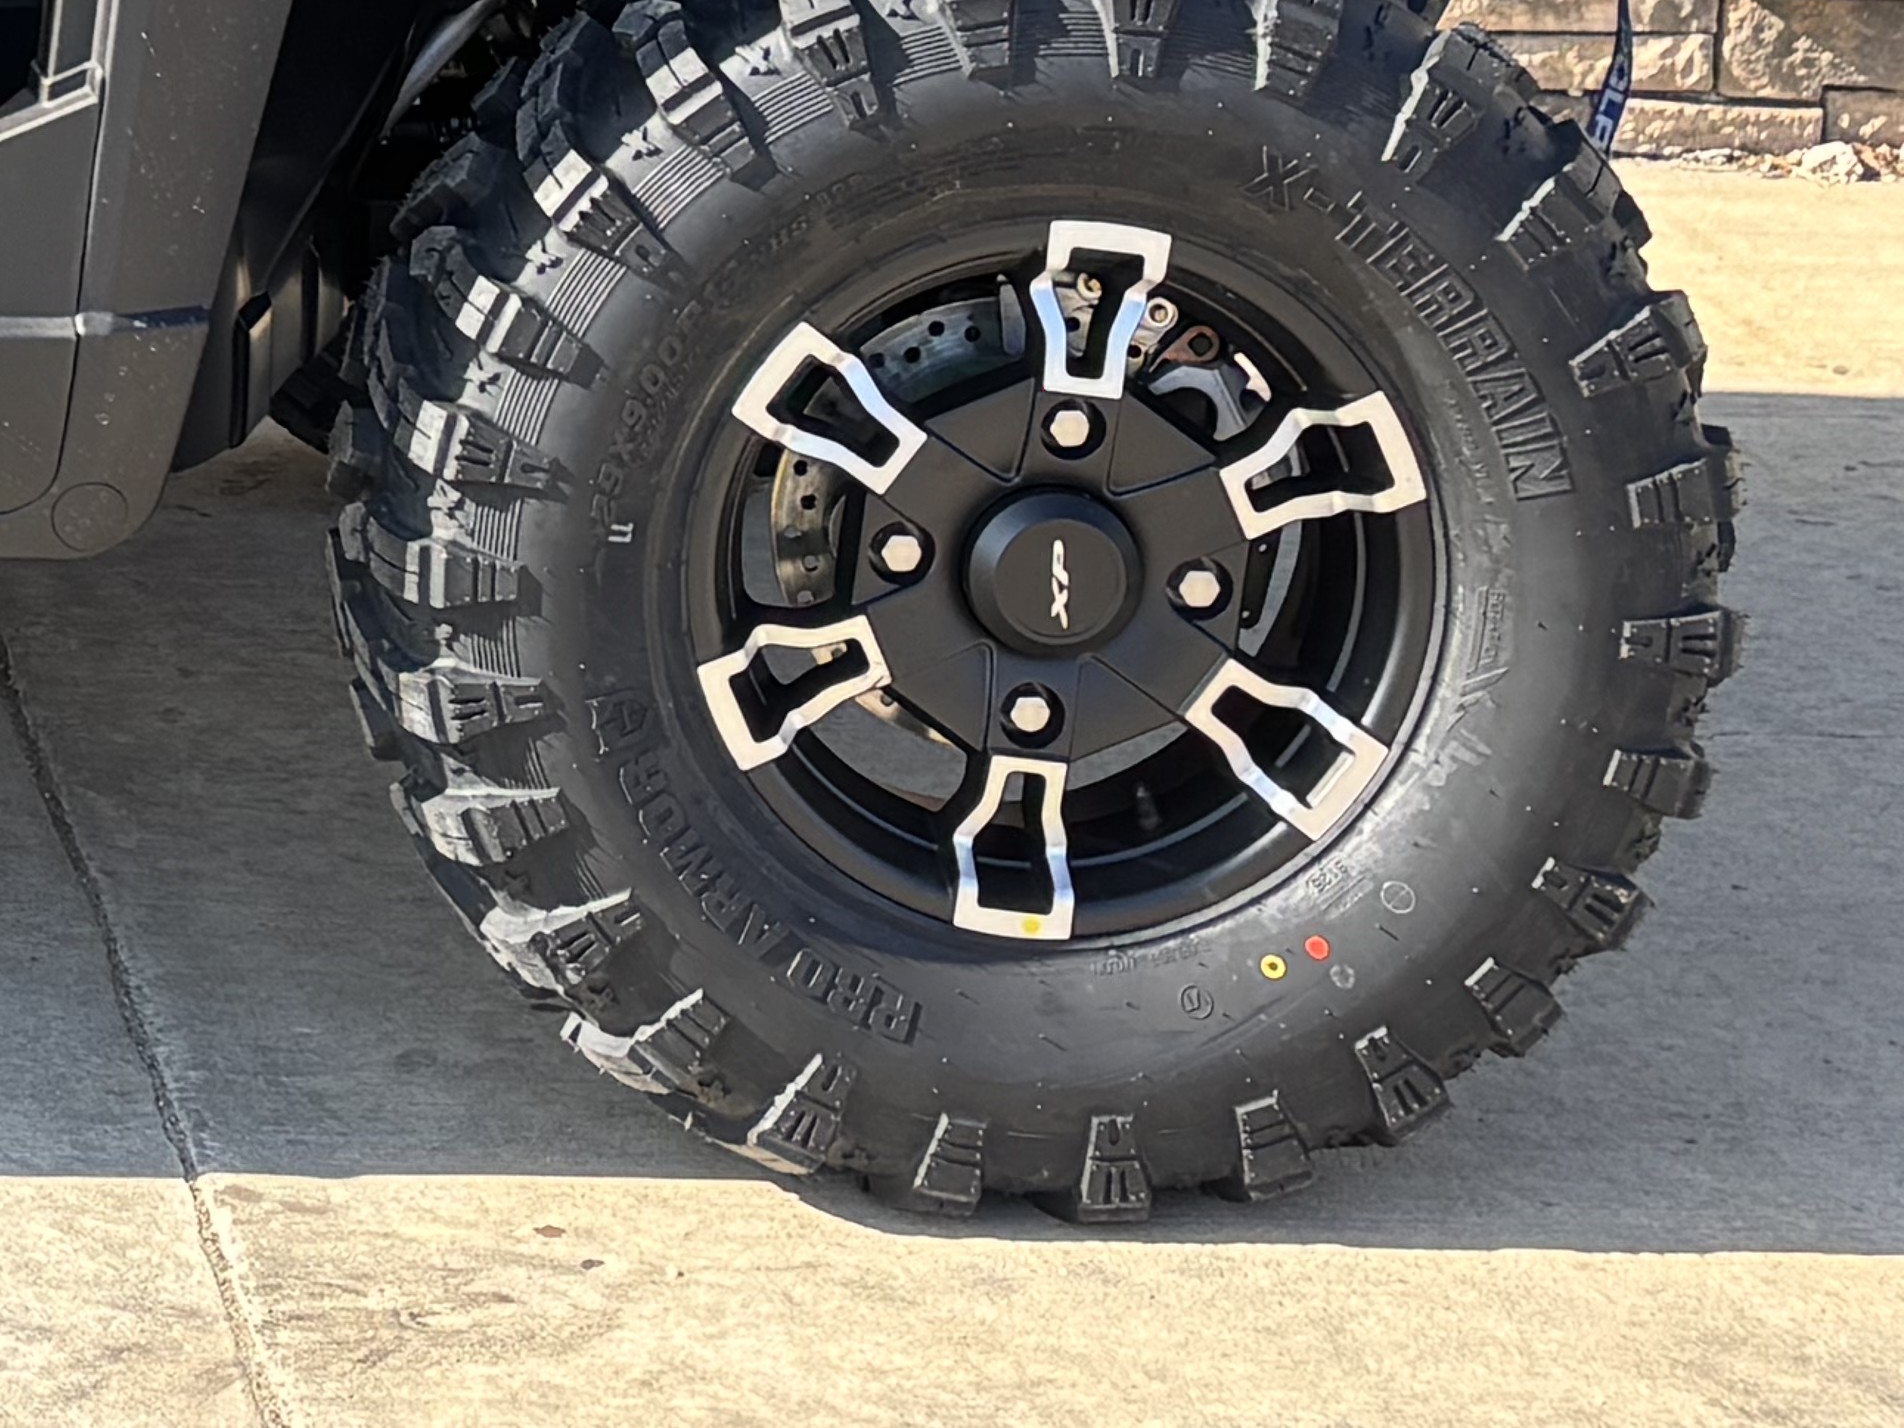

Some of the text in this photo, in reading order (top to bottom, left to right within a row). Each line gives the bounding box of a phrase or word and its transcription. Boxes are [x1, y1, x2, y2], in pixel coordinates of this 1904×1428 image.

[1240, 145, 1574, 502] X-TERRAIN
[1050, 539, 1069, 629] XP
[620, 750, 922, 1046] PRO ARMOR
